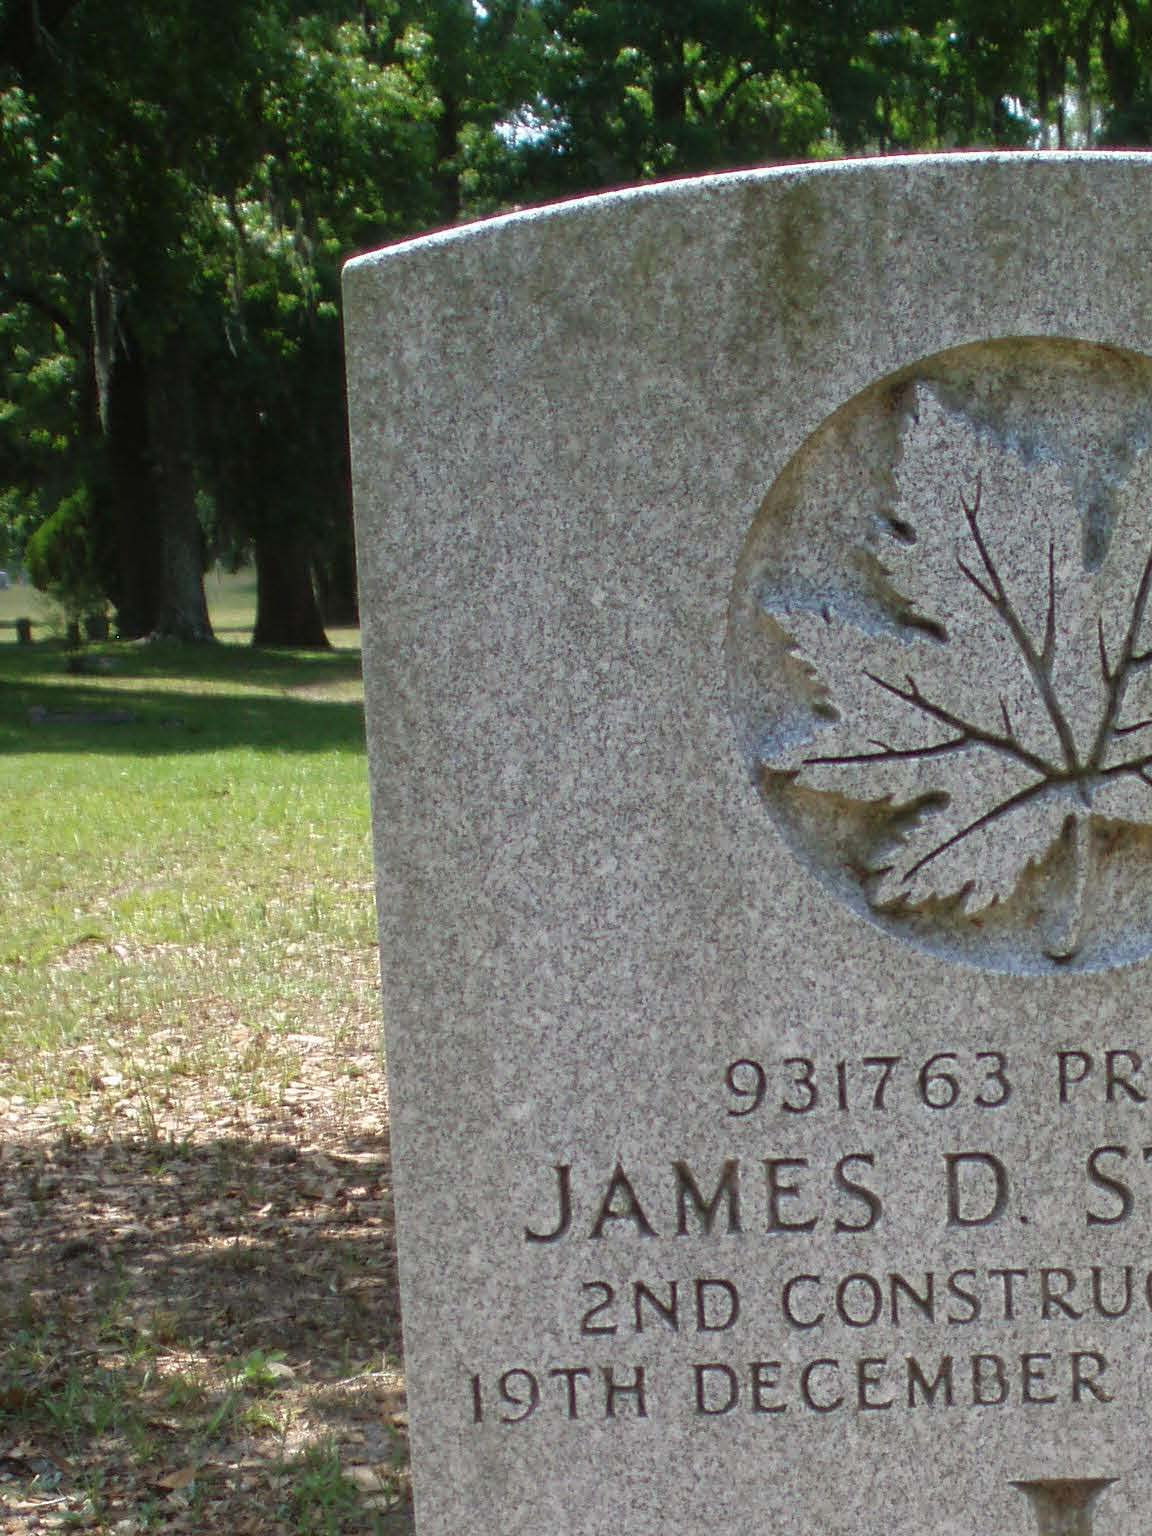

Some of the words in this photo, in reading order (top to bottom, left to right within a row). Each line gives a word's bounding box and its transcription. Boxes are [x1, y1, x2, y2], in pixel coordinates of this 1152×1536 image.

[725, 1051, 1012, 1116] 931763
[524, 1153, 884, 1243] JAMES
[941, 1151, 1030, 1228] D.
[580, 1278, 742, 1336] 2ND
[471, 1364, 648, 1423] 19TH
[694, 1348, 1114, 1416] DECEMBER
